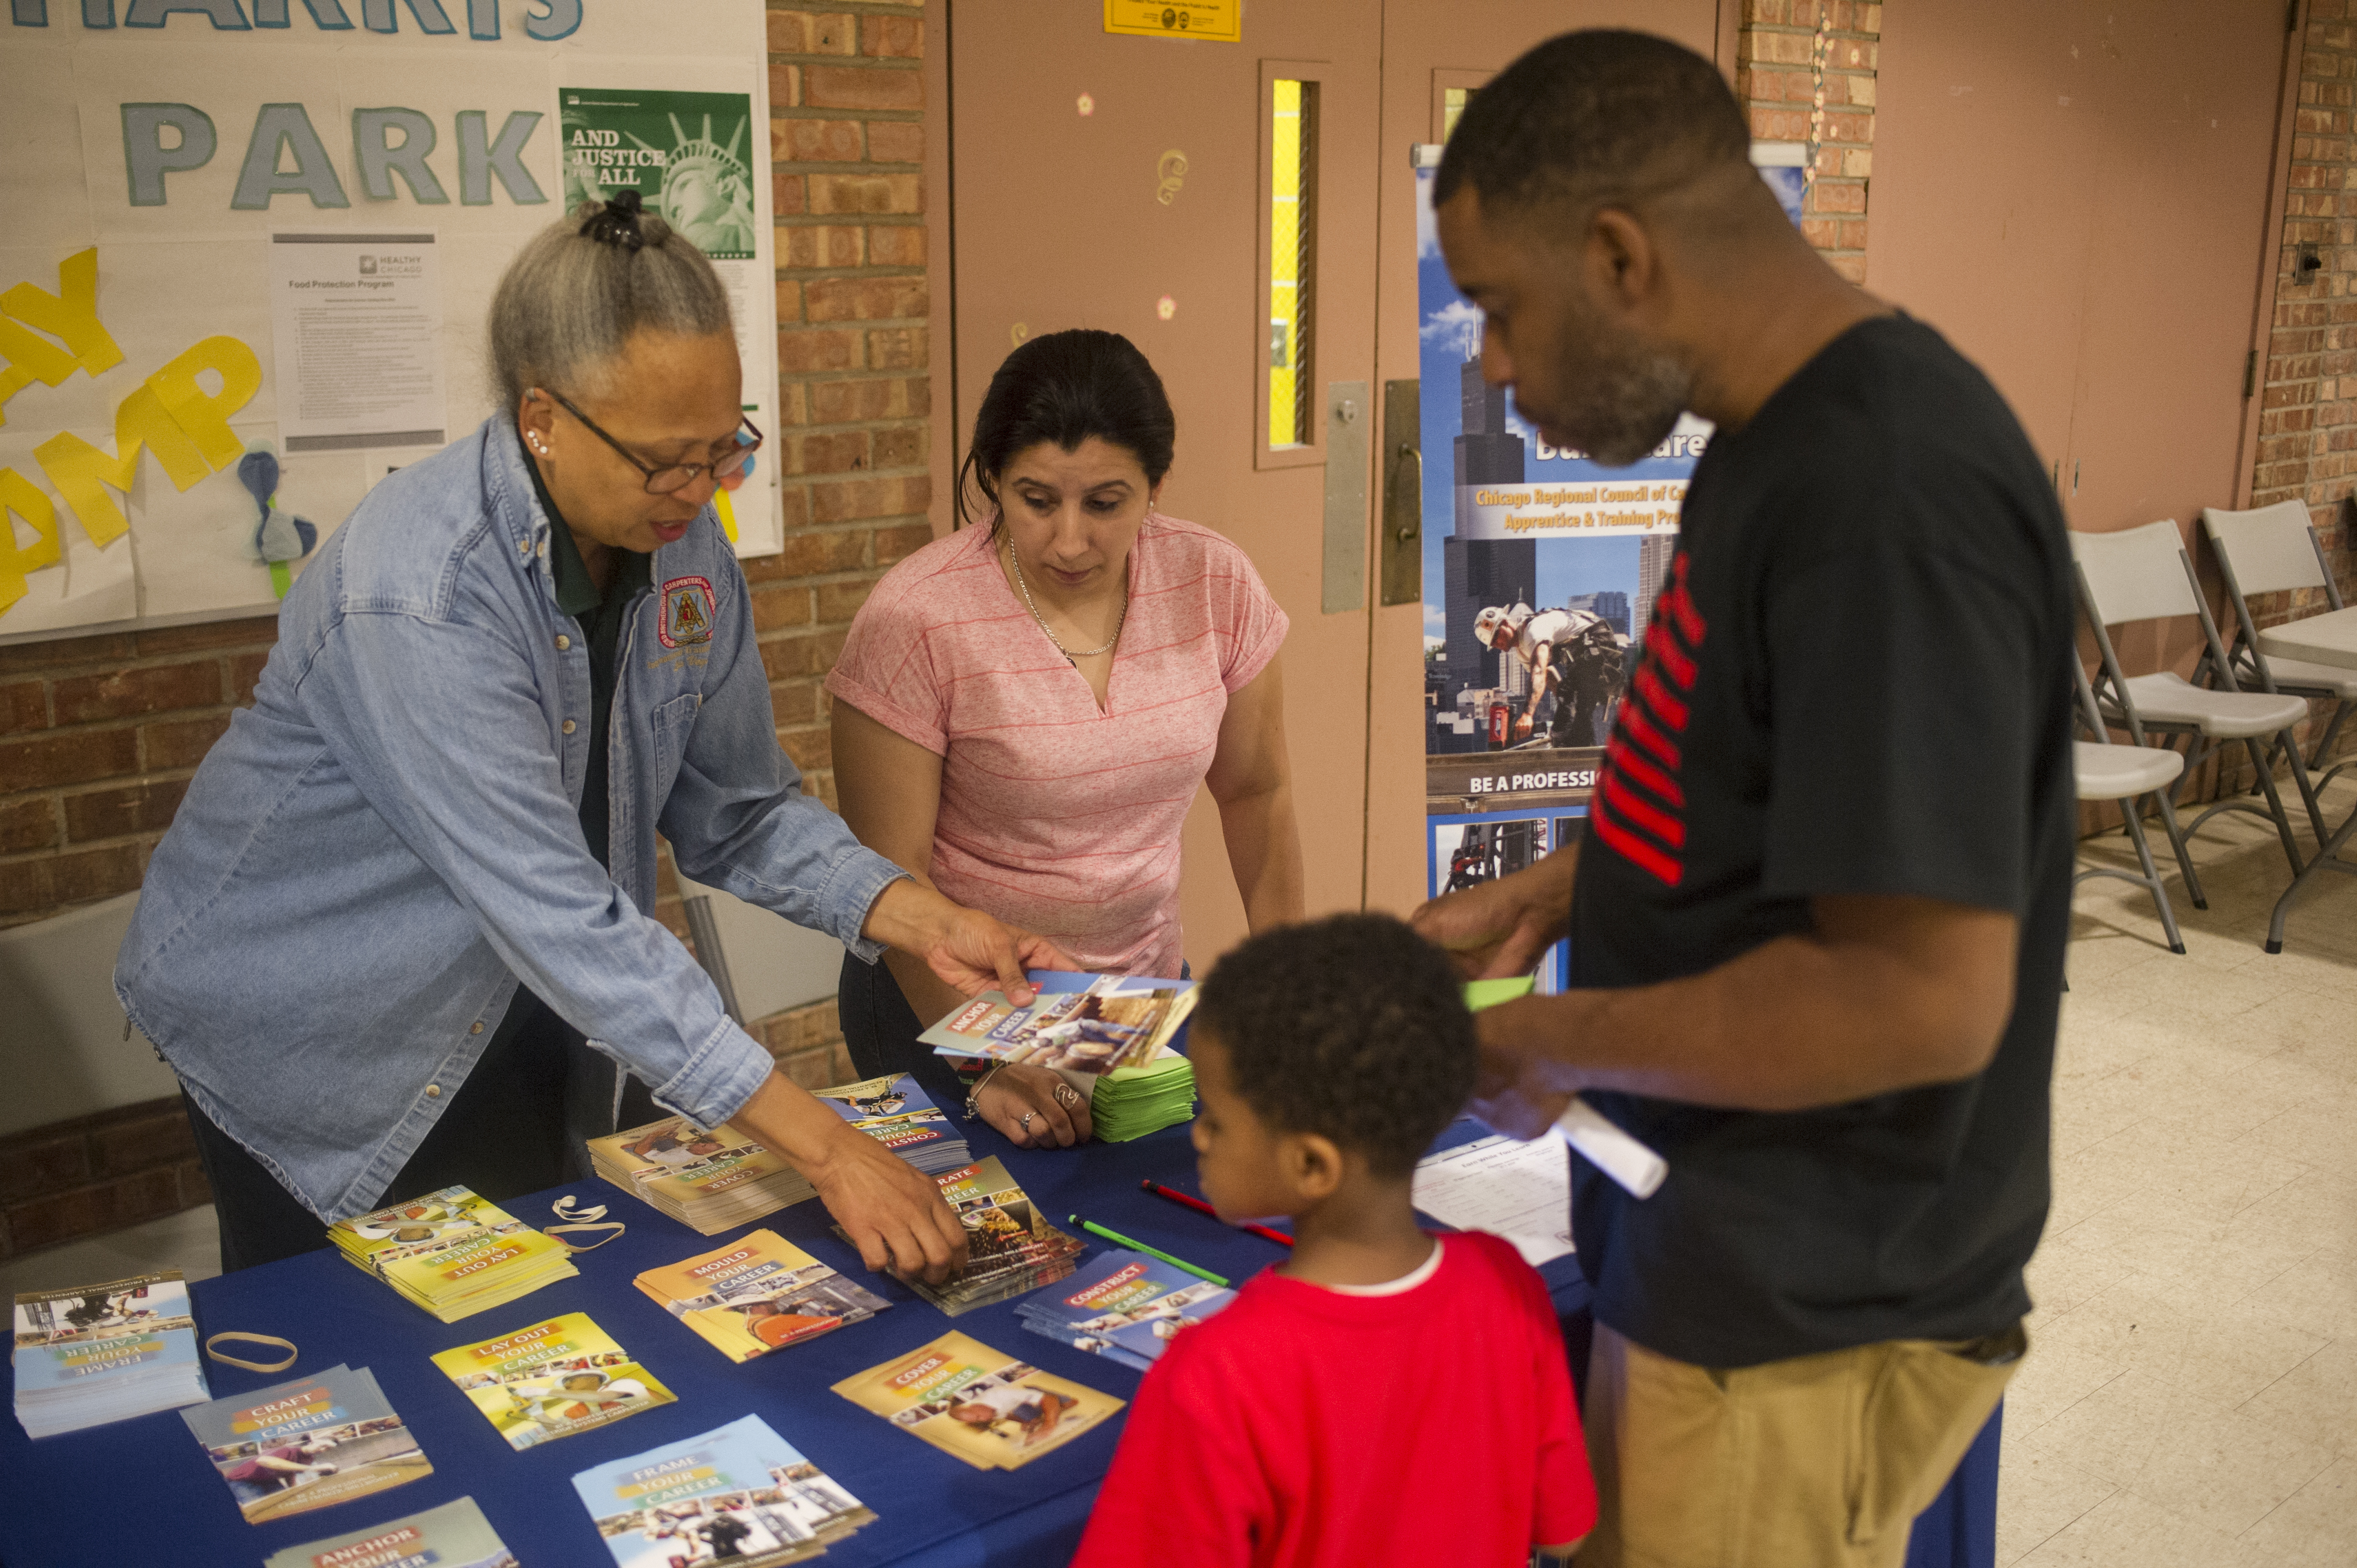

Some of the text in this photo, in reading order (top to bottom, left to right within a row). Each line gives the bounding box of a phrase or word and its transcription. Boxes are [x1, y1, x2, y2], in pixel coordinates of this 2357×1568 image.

[572, 129, 620, 147] AND
[120, 102, 549, 210] PARK
[571, 148, 666, 167] JUSTICE
[598, 168, 641, 185] ALL
[289, 280, 394, 291] Food Protection Program
[1476, 485, 1689, 508] Chicago Regional Council of Ca
[1504, 510, 1681, 532] Apprentice & Training Pro
[665, 577, 702, 590] CARPENTERS
[1470, 770, 1600, 793] BE A PROFESSI
[951, 1000, 991, 1033] ANCHOR
[972, 1012, 1005, 1035] YOUR
[992, 1010, 1030, 1039] CAREER
[864, 1123, 910, 1136] CAREE
[876, 1130, 917, 1142] YOUR
[685, 1159, 736, 1180] CAREER
[706, 1165, 747, 1180] YOUR
[707, 1169, 754, 1189] COVER
[431, 1238, 491, 1265] CAREER
[454, 1245, 526, 1278] LAY OUT
[457, 1246, 501, 1265] YOUR
[693, 1251, 749, 1276] MOULD
[705, 1263, 752, 1282] YOUR
[719, 1264, 777, 1290] CAREER
[1070, 1264, 1141, 1306] CONSTRUCT
[1097, 1285, 1137, 1303] YOUR
[1114, 1284, 1162, 1313] CAREER
[65, 1335, 142, 1357] CAREER
[478, 1327, 549, 1356] LAY OUT
[495, 1341, 547, 1360] YOUR
[88, 1345, 143, 1362] YOUR
[503, 1344, 571, 1371] CAREER
[75, 1355, 142, 1377] FRAME
[895, 1357, 943, 1385] COVER
[909, 1368, 953, 1391] YOUR
[925, 1368, 979, 1401] CAREER
[251, 1392, 313, 1417] CRAFT
[255, 1407, 310, 1428] YOUR
[261, 1410, 337, 1438] CAREER
[632, 1455, 699, 1481] FRAME
[639, 1470, 695, 1490] YOUR
[645, 1476, 723, 1506] CAREER
[321, 1529, 415, 1565] ANCHOR
